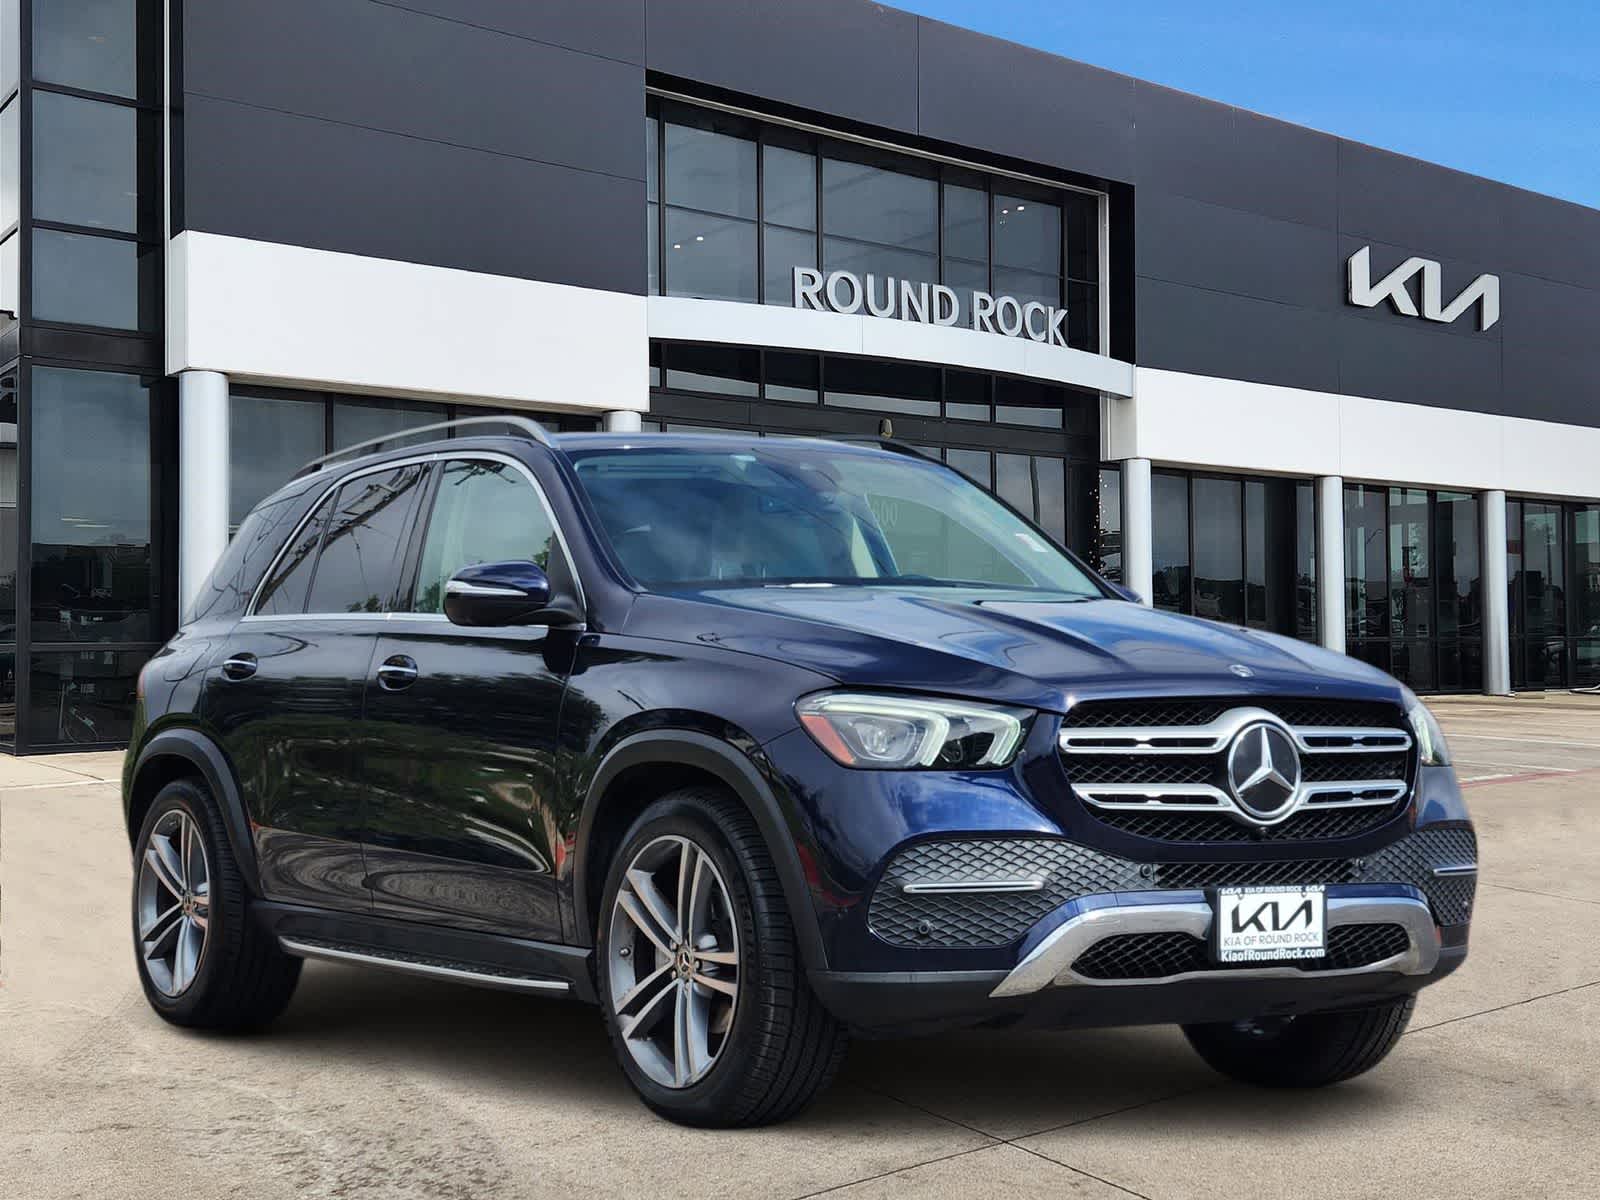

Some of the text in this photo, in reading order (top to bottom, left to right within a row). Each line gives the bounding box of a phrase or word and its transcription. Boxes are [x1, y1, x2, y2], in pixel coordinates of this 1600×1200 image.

[1348, 245, 1500, 332] KIA
[792, 266, 1068, 348] ROUND ROCK
[1231, 899, 1313, 934] KIA
[1221, 947, 1326, 962] KiaofRoundRock.com
[1223, 932, 1319, 947] KIA OF ROUND ROCK
